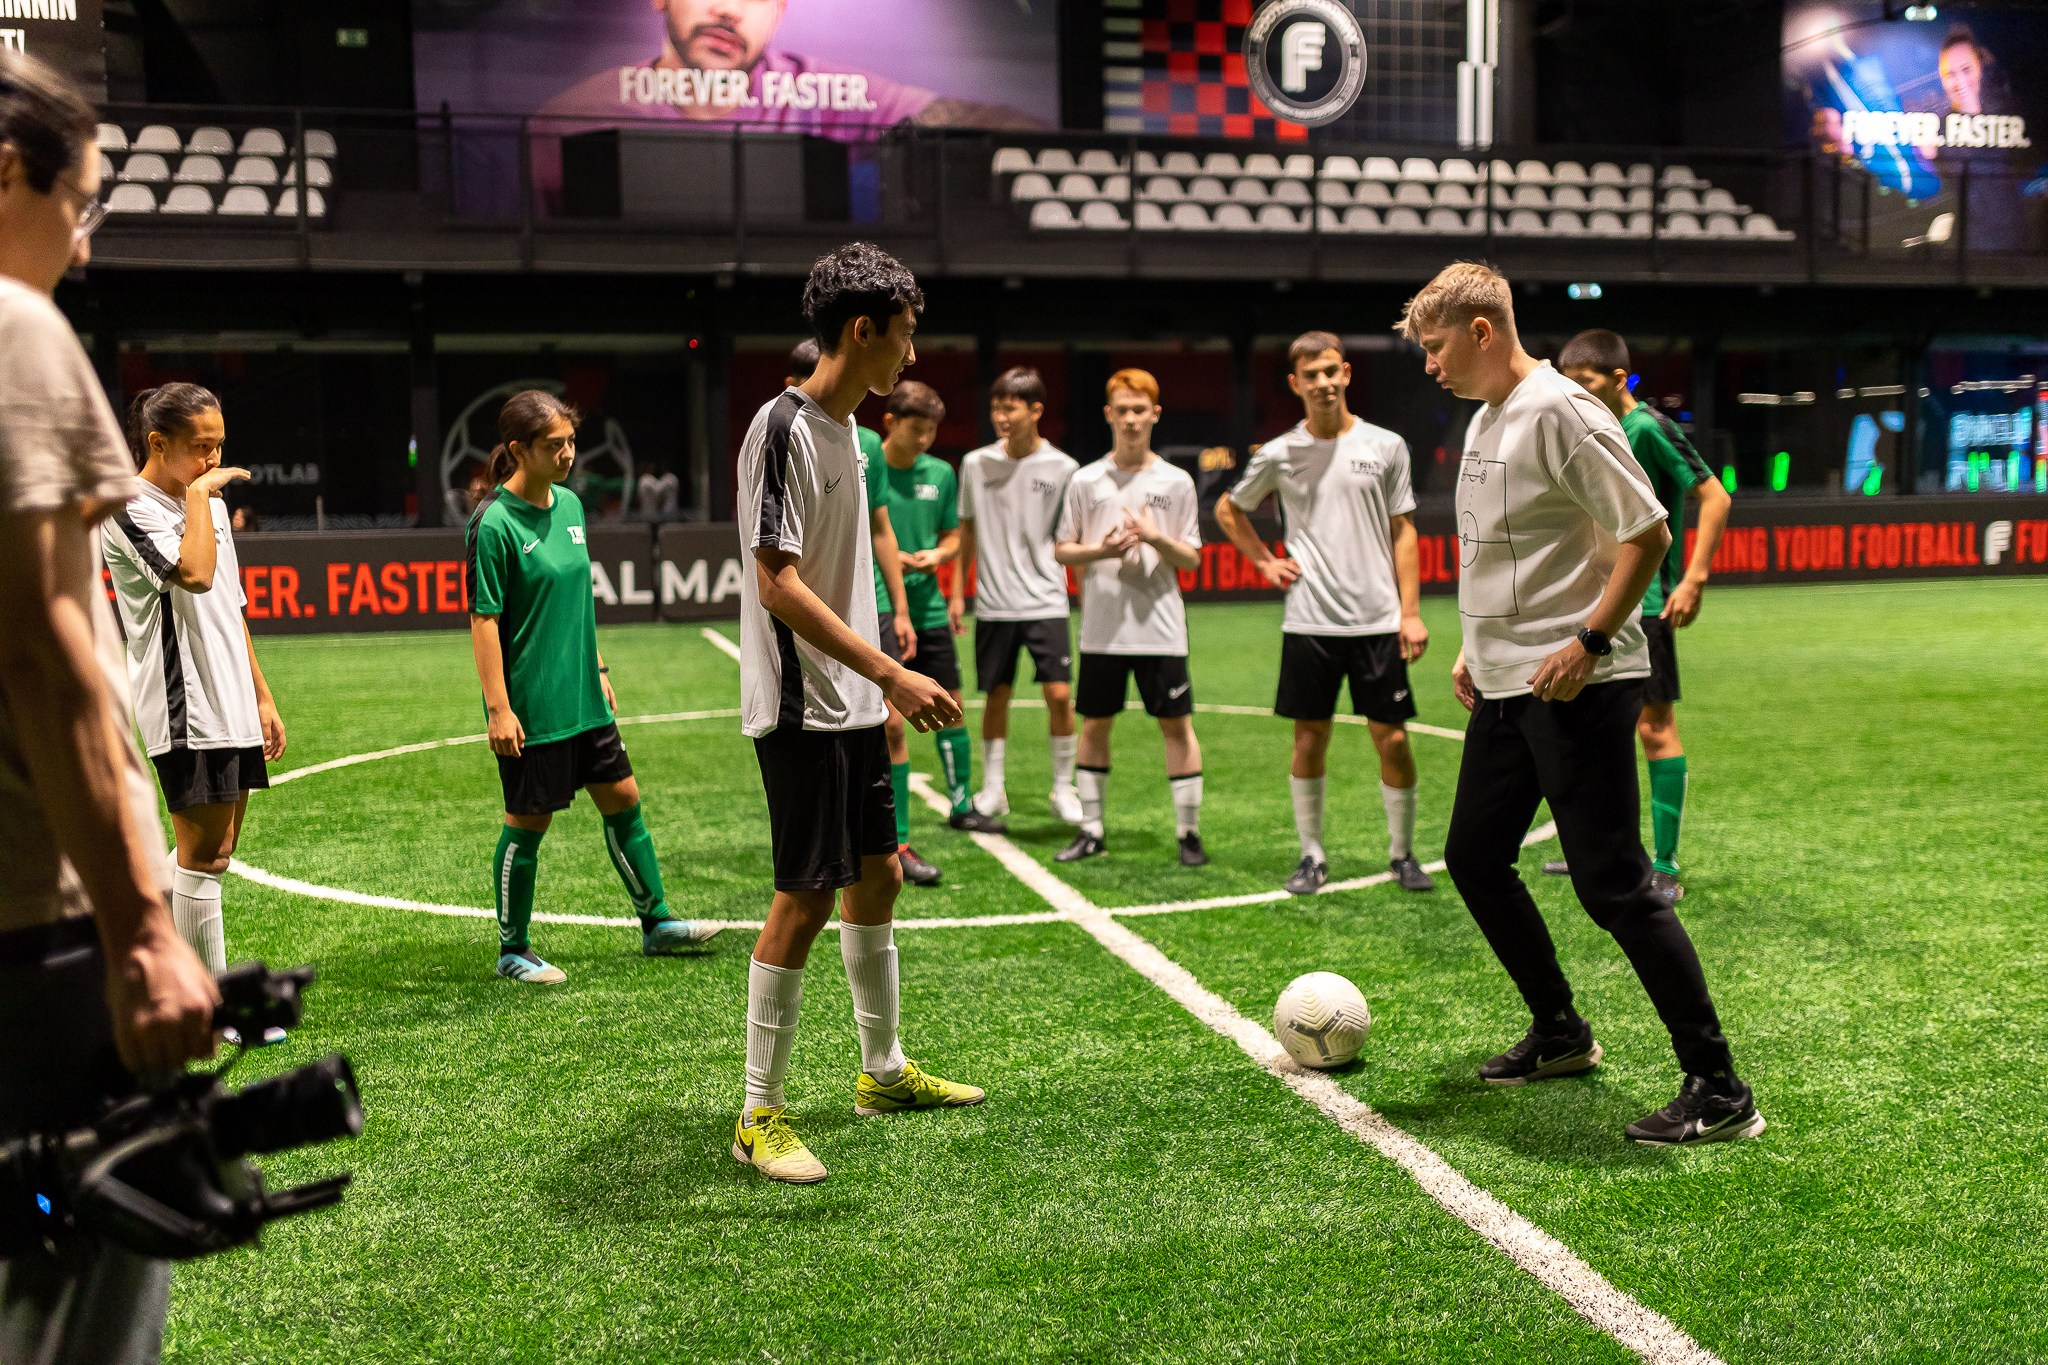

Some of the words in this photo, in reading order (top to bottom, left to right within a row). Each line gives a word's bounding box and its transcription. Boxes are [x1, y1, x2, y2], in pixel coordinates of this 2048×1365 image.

[619, 67, 758, 108] FOREVER.
[762, 71, 877, 111] FASTER.
[1842, 110, 1944, 147] FOREVER.
[1945, 112, 2031, 148] FASTER.
[232, 463, 319, 485] OTLAB
[1773, 525, 1845, 571] YOUR
[1850, 521, 1980, 569] FOOTBALL
[239, 565, 317, 619] ER.
